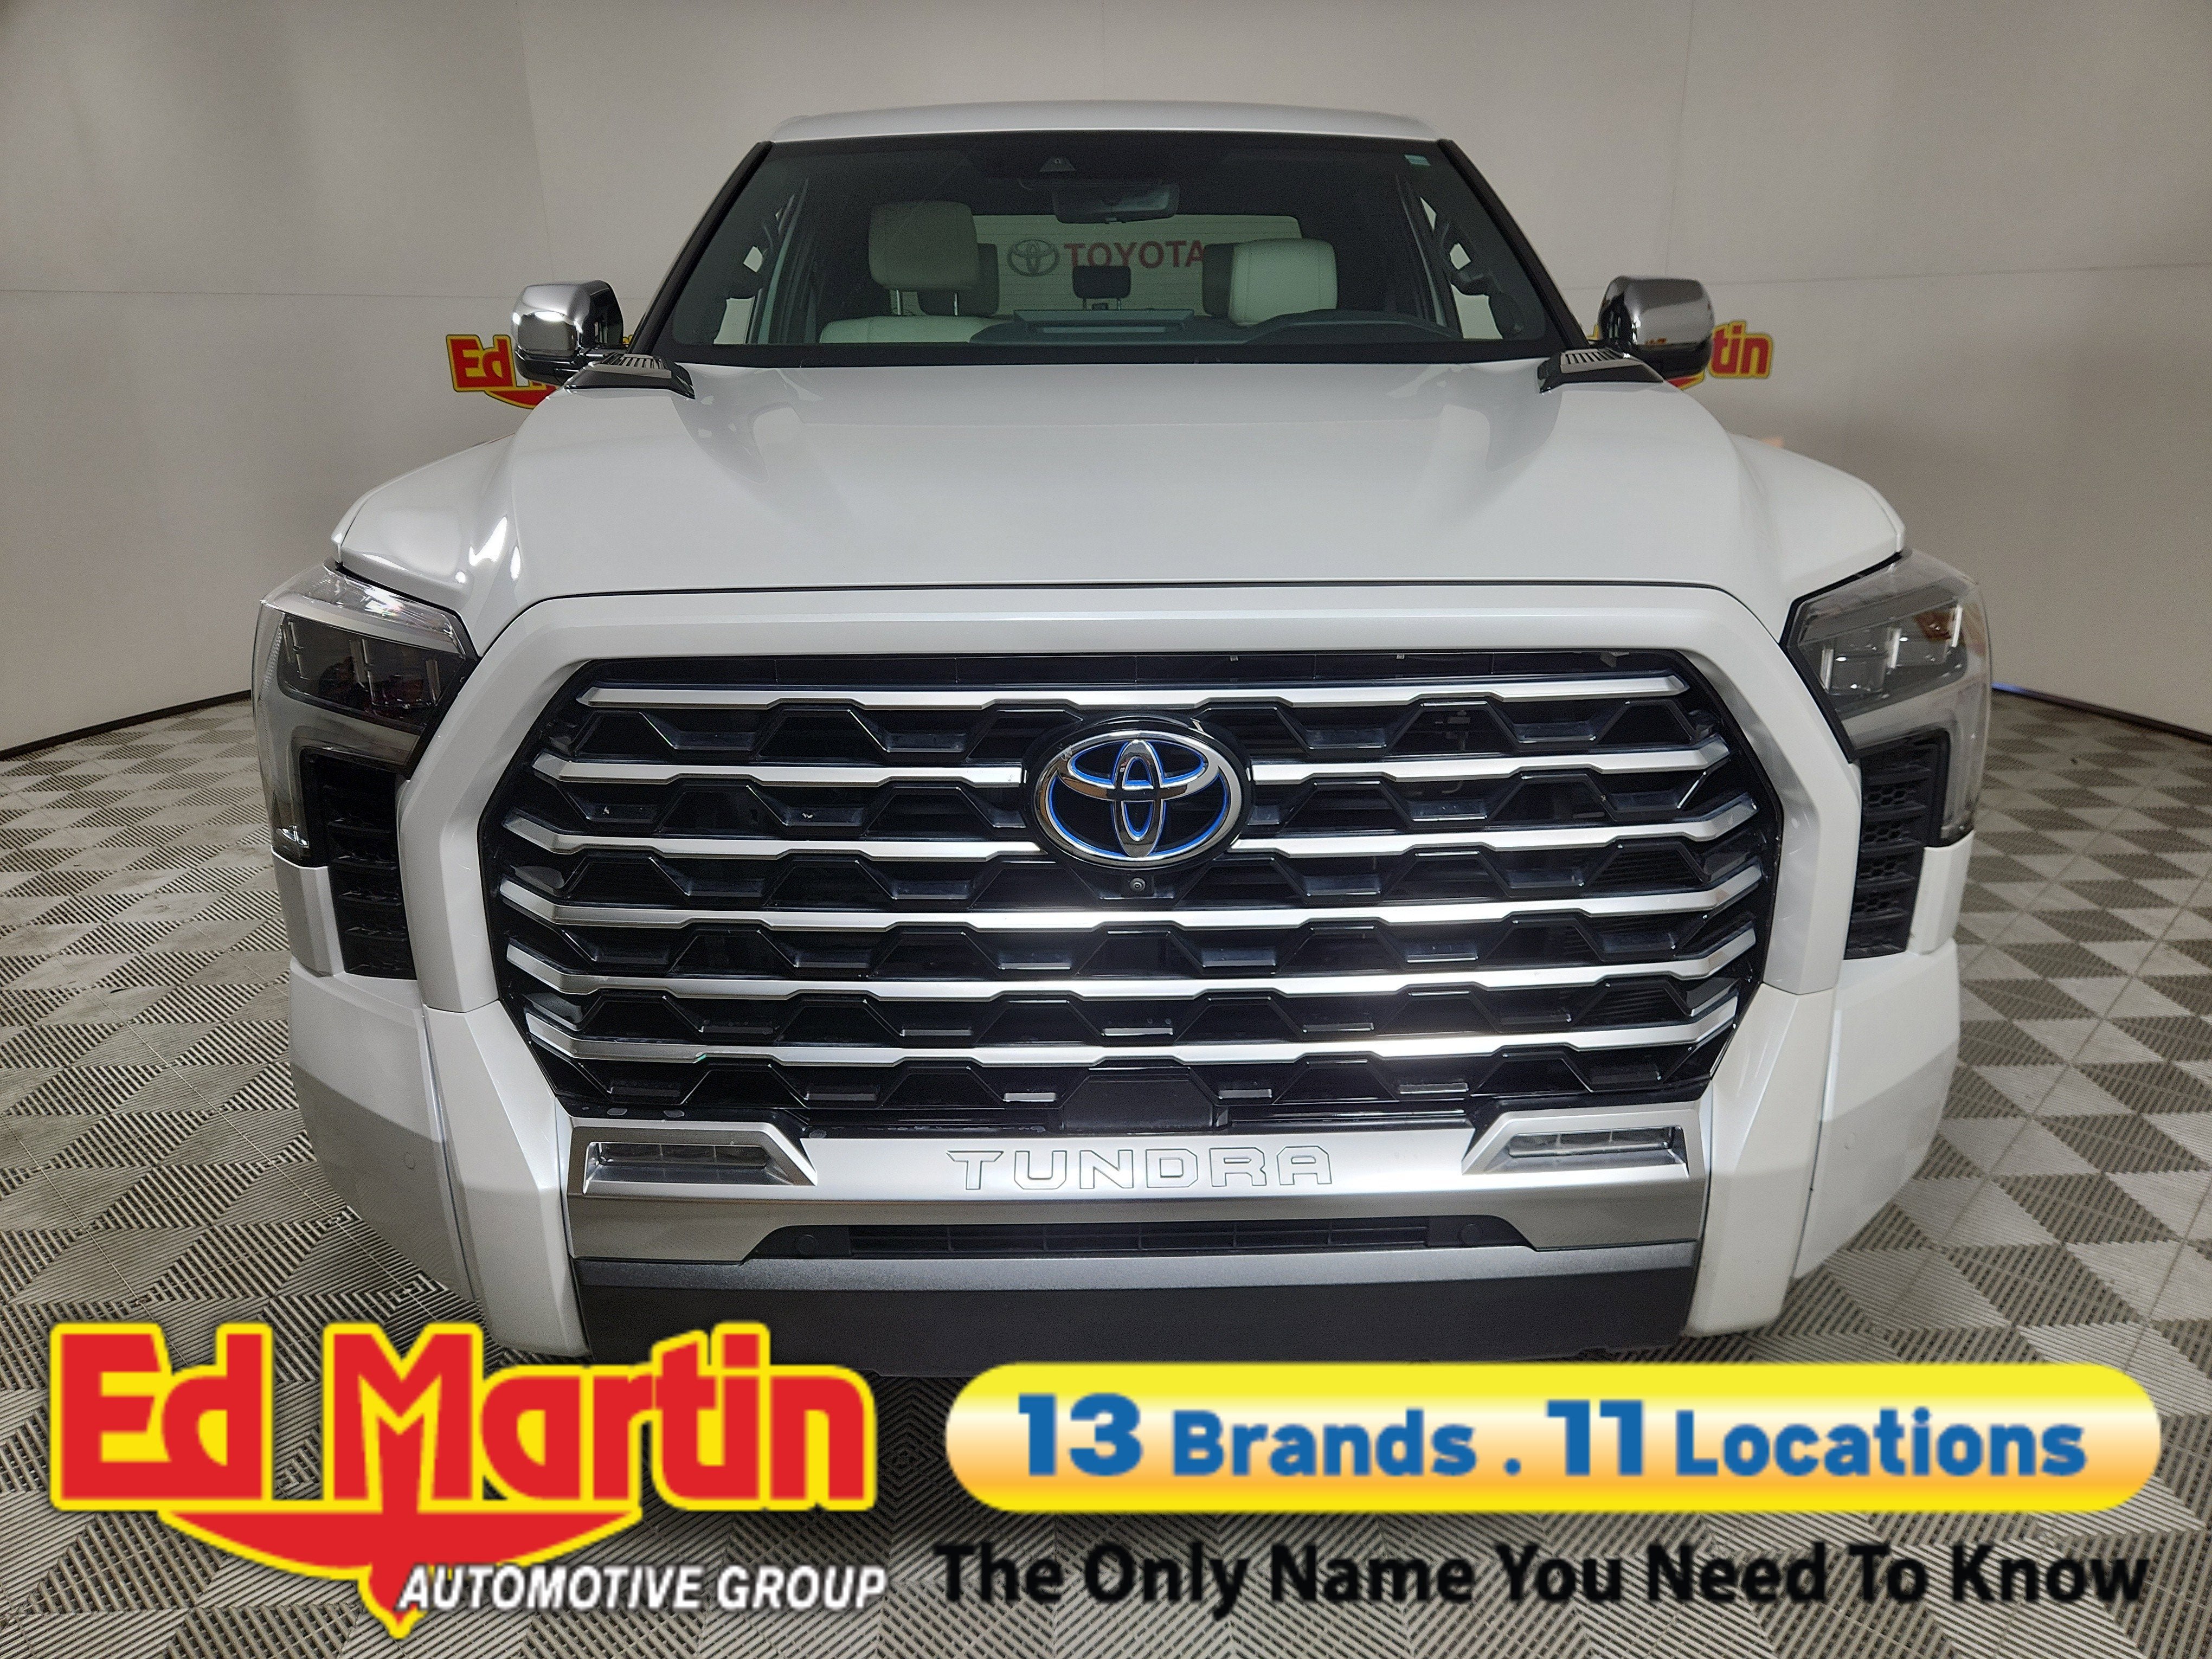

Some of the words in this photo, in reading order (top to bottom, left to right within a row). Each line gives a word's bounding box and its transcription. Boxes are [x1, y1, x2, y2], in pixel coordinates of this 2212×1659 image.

[1064, 240, 1205, 269] TOYOTA
[446, 335, 517, 392] Ed
[945, 1144, 1333, 1190] TUNDRA
